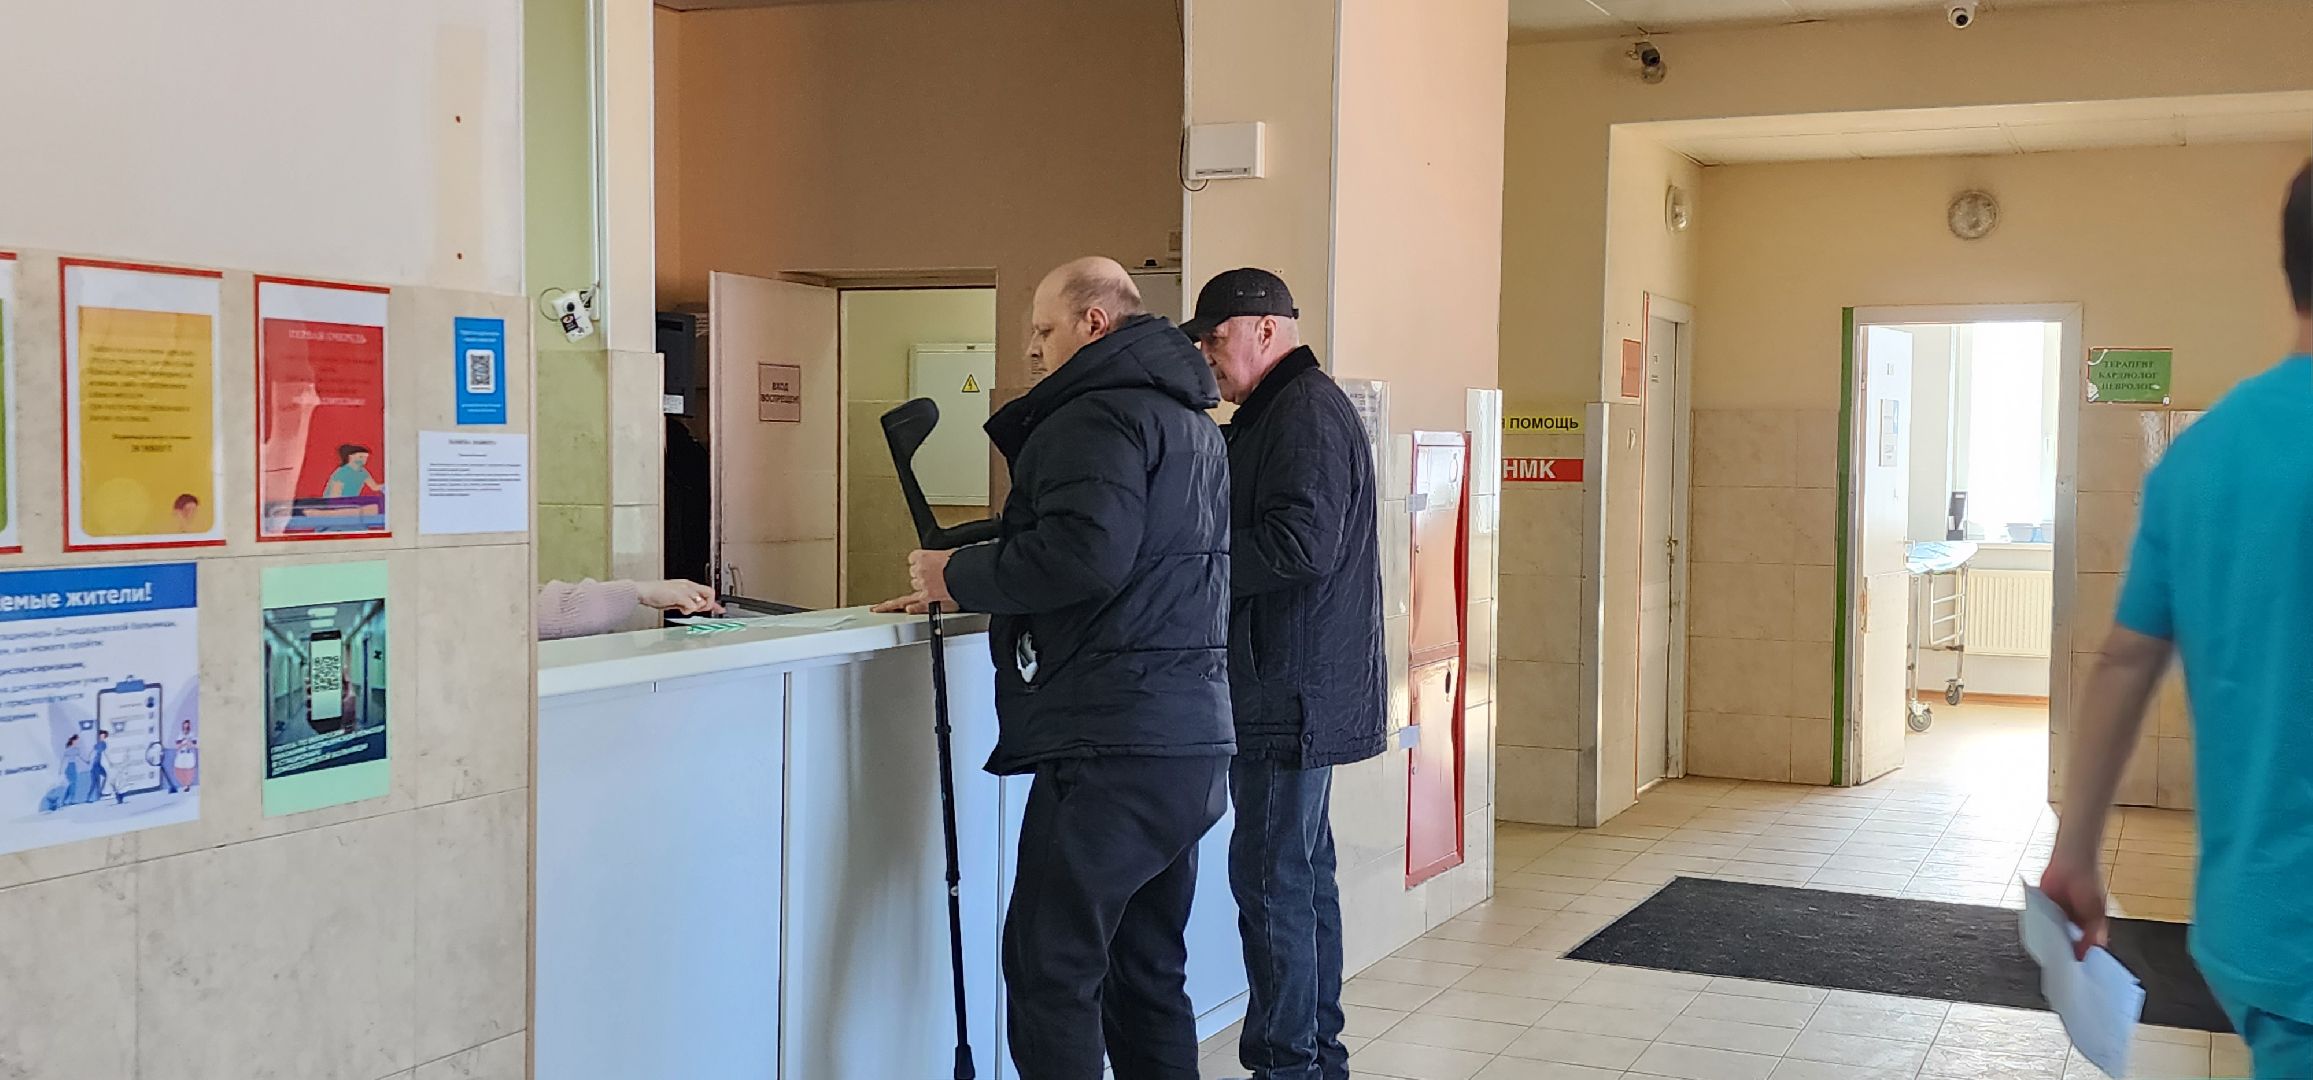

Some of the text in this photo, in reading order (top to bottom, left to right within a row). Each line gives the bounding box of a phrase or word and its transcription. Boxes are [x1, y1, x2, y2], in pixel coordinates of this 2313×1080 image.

[2104, 360, 2155, 369] ТЕРАПЕВТ
[2098, 371, 2158, 380] КАРДИОЛОГ
[1509, 417, 1579, 431] ПОМОЩЬ
[1503, 459, 1557, 479] НМК
[65, 582, 153, 607] жители!
